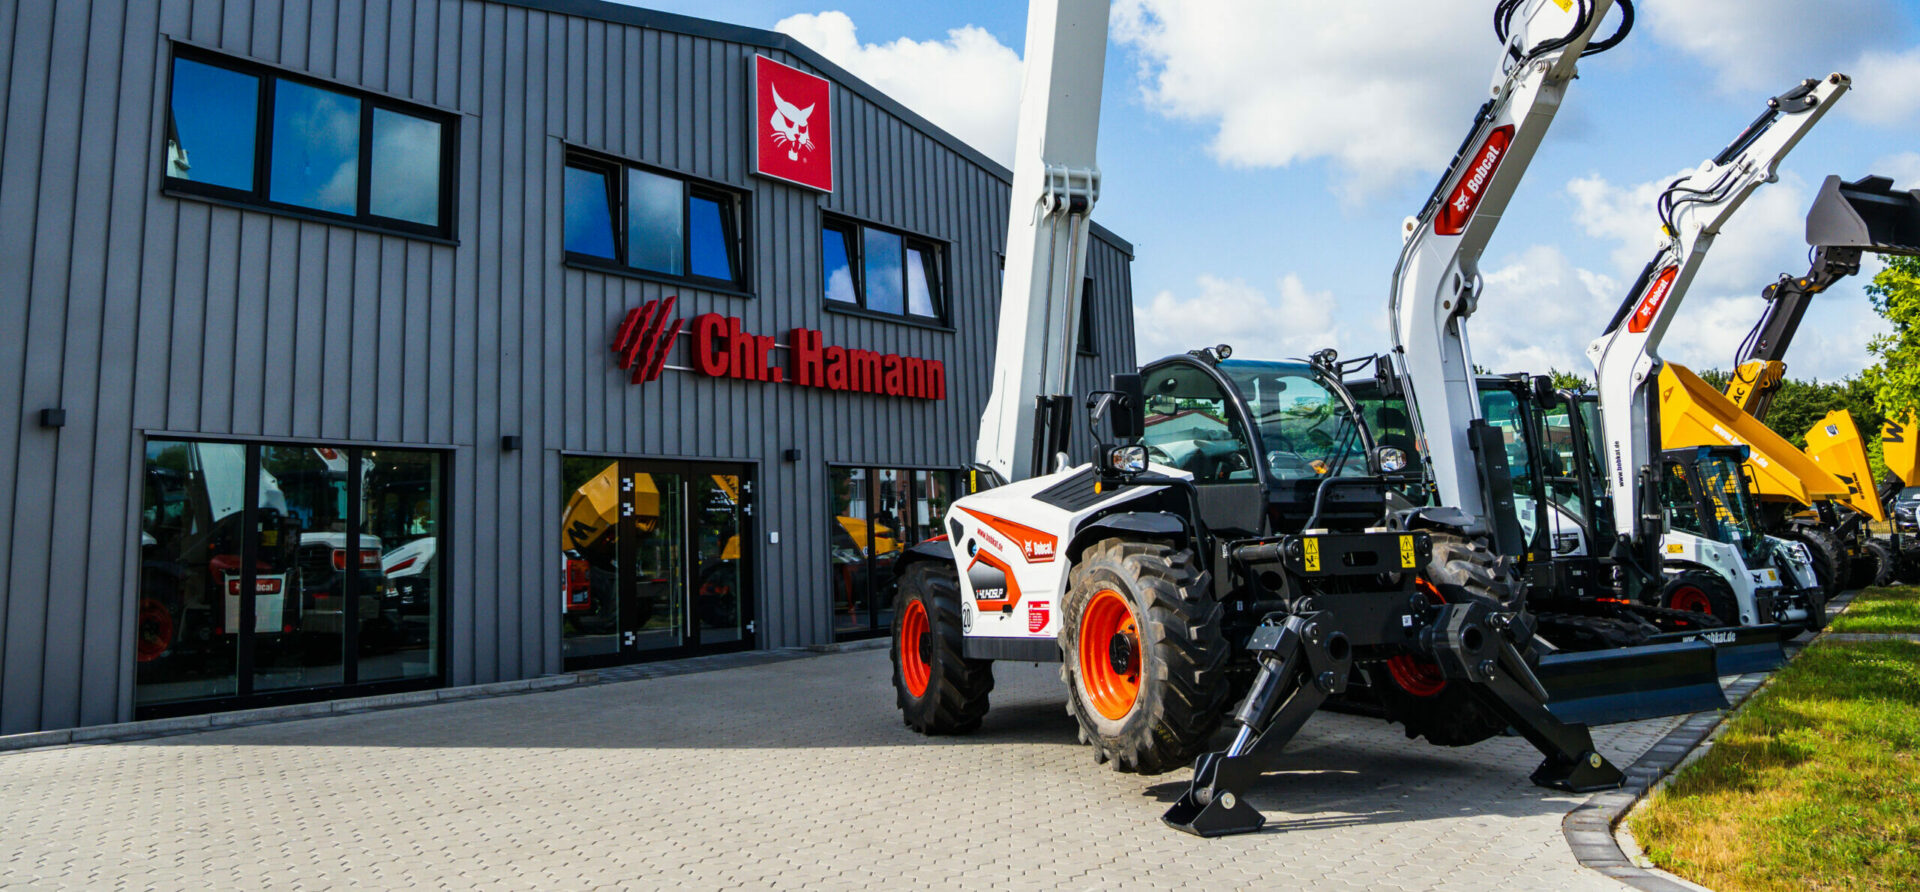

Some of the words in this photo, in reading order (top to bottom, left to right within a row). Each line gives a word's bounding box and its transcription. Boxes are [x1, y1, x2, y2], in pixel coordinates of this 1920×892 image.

[1467, 145, 1500, 194] Bobcat
[1649, 279, 1669, 306] Bobcat
[691, 312, 783, 383] Chr.
[790, 327, 946, 400] Hamann
[1614, 440, 1625, 488] www.bobkat.de
[1033, 541, 1054, 556] Bobcat
[963, 608, 972, 628] 20
